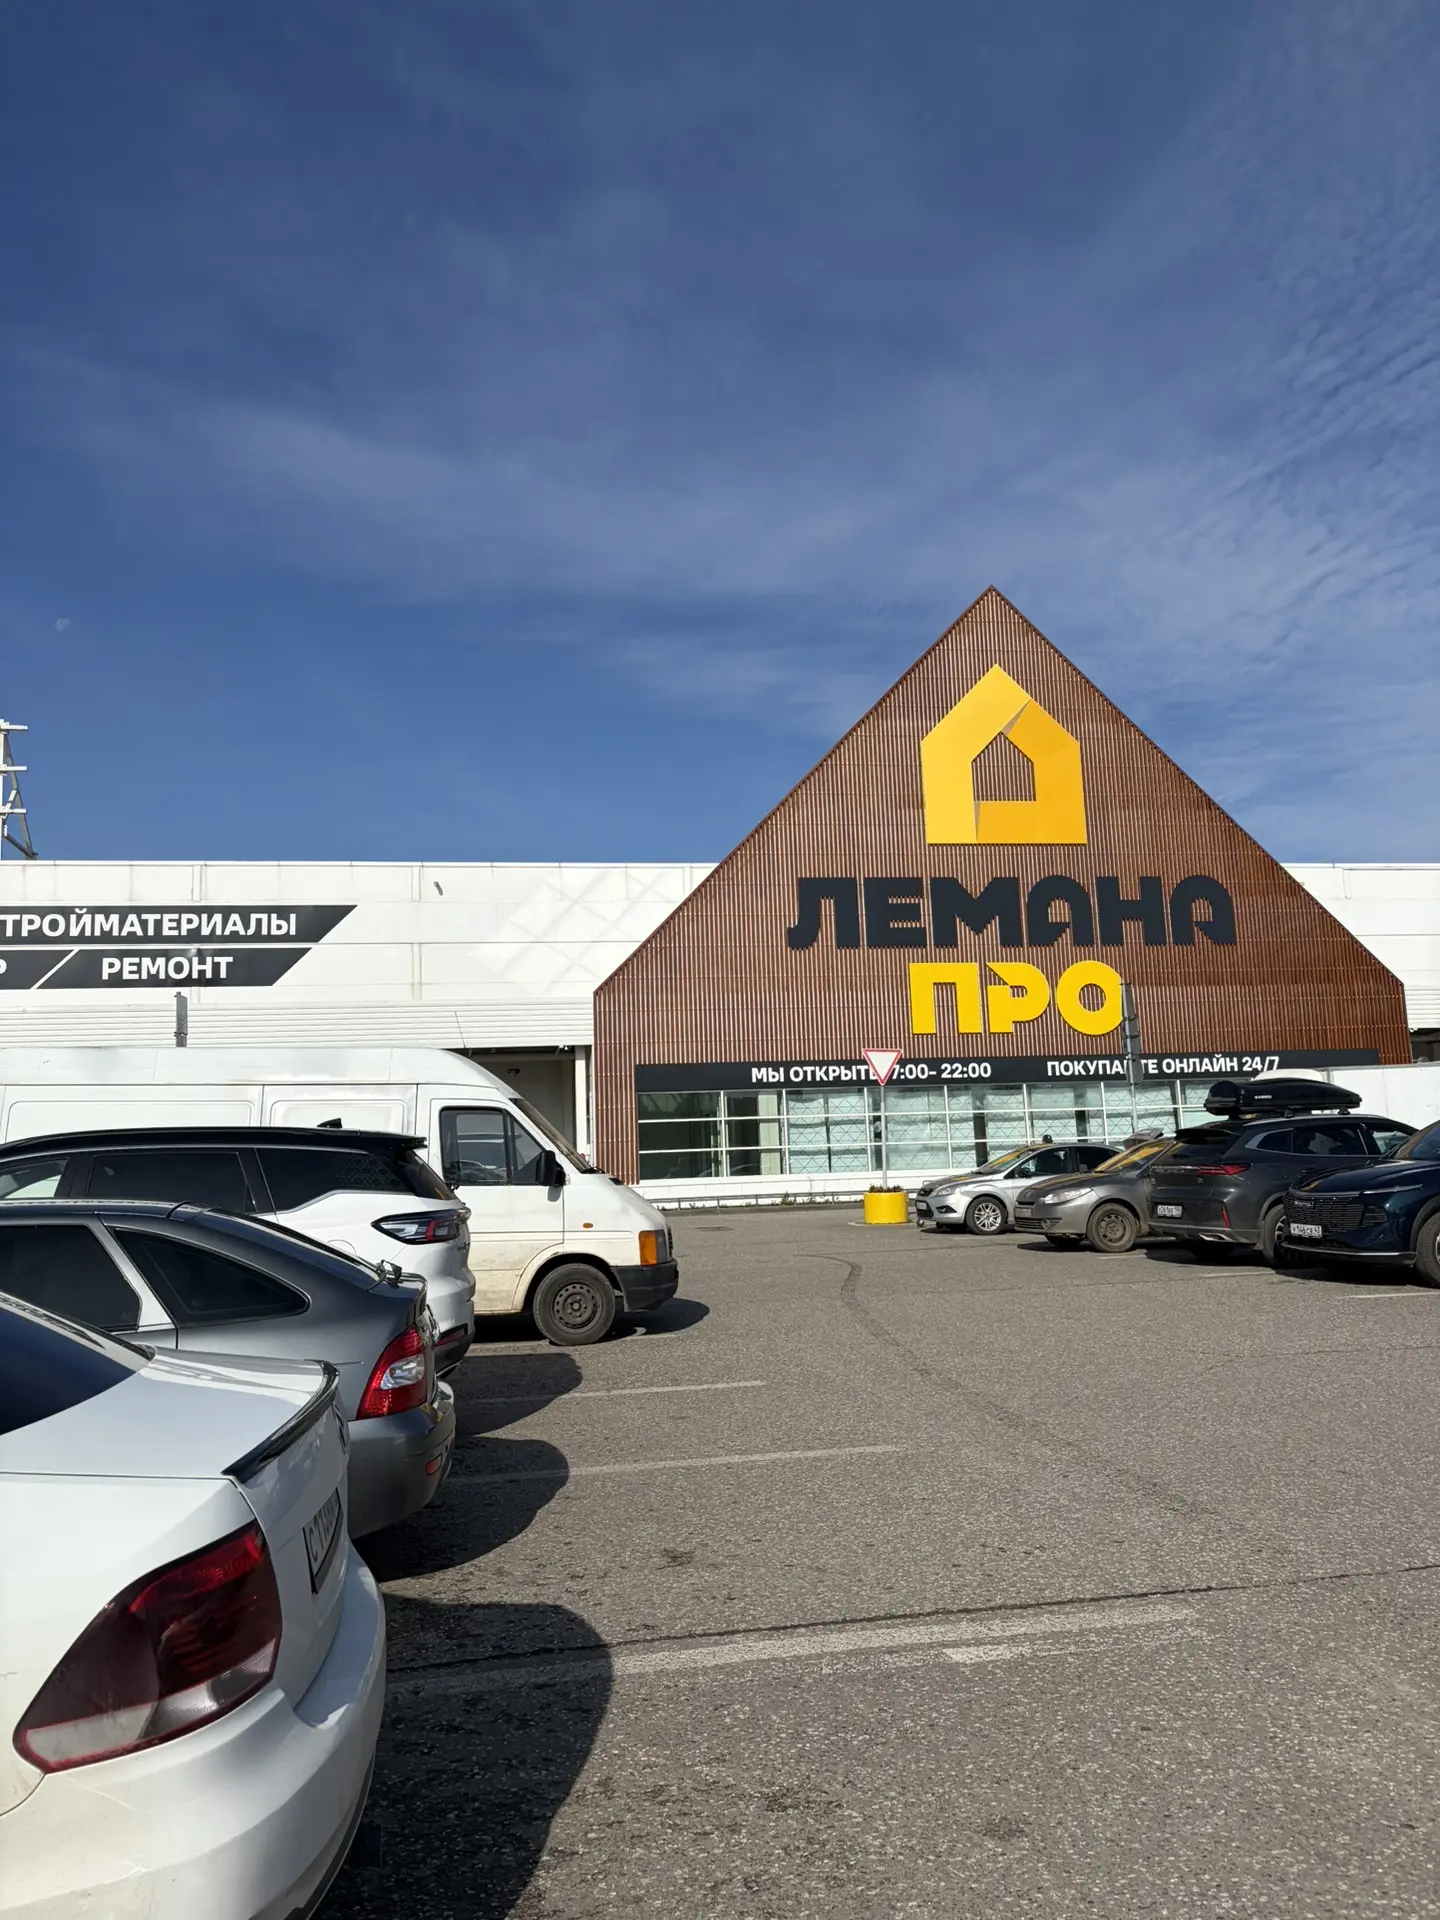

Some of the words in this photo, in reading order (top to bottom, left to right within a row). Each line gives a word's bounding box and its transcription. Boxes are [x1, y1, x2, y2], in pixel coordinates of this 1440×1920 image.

[787, 874, 1237, 950] ЛЕМАНА
[101, 956, 234, 980] РЕМОНТ
[908, 960, 1126, 1035] ПРО
[751, 1067, 785, 1083] МЫ
[941, 1063, 992, 1079] 22:00
[1162, 1054, 1239, 1074] ОНЛАЙН
[1241, 1056, 1280, 1072] 24/7
